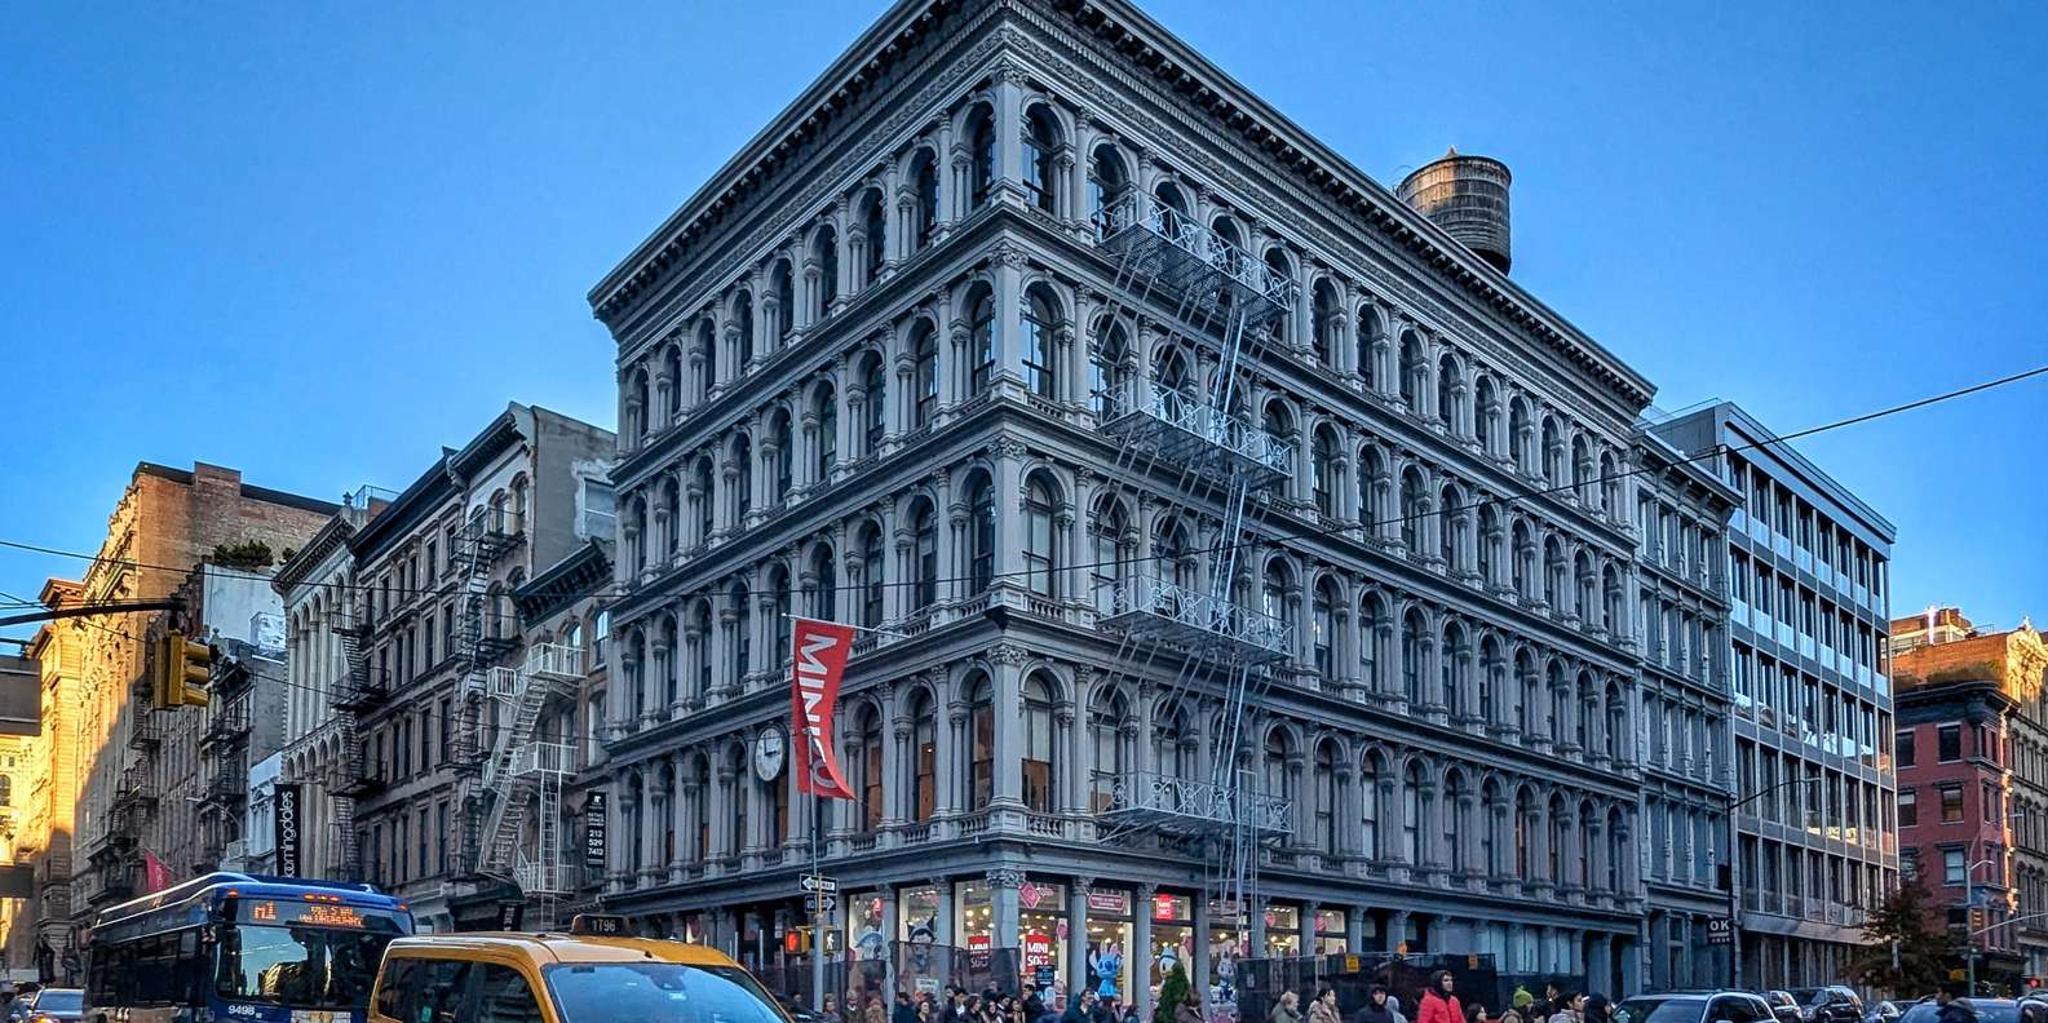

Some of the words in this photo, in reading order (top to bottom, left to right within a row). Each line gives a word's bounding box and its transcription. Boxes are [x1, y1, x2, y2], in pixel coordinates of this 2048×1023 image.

[1710, 920, 1730, 931] OK
[1027, 942, 1049, 953] MINI
[228, 1004, 255, 1016] 9498
